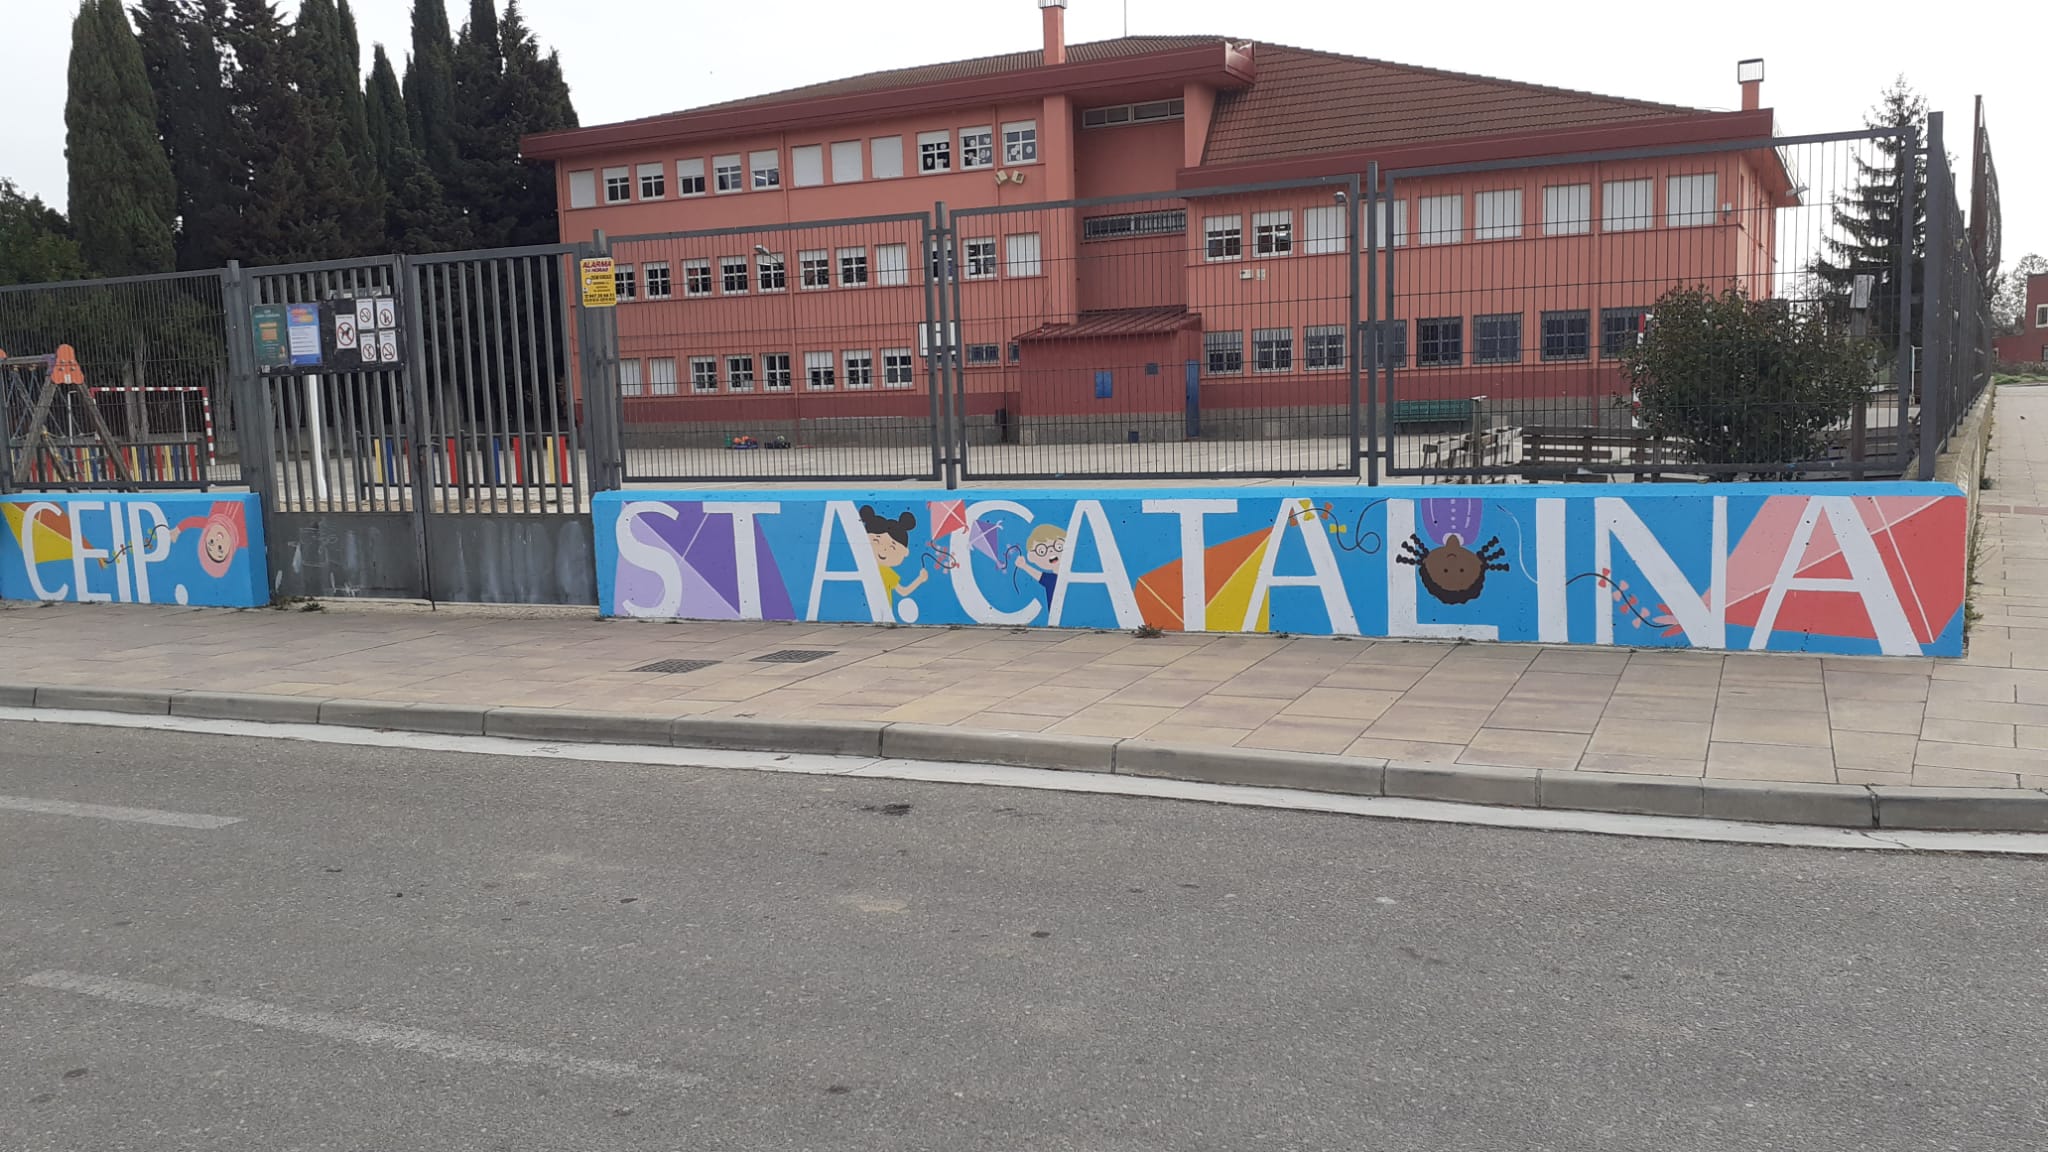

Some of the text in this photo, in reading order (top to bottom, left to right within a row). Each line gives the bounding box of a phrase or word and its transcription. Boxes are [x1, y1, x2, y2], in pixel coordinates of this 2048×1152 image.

[22, 496, 1924, 657] CEIP. STA. CATALINA
